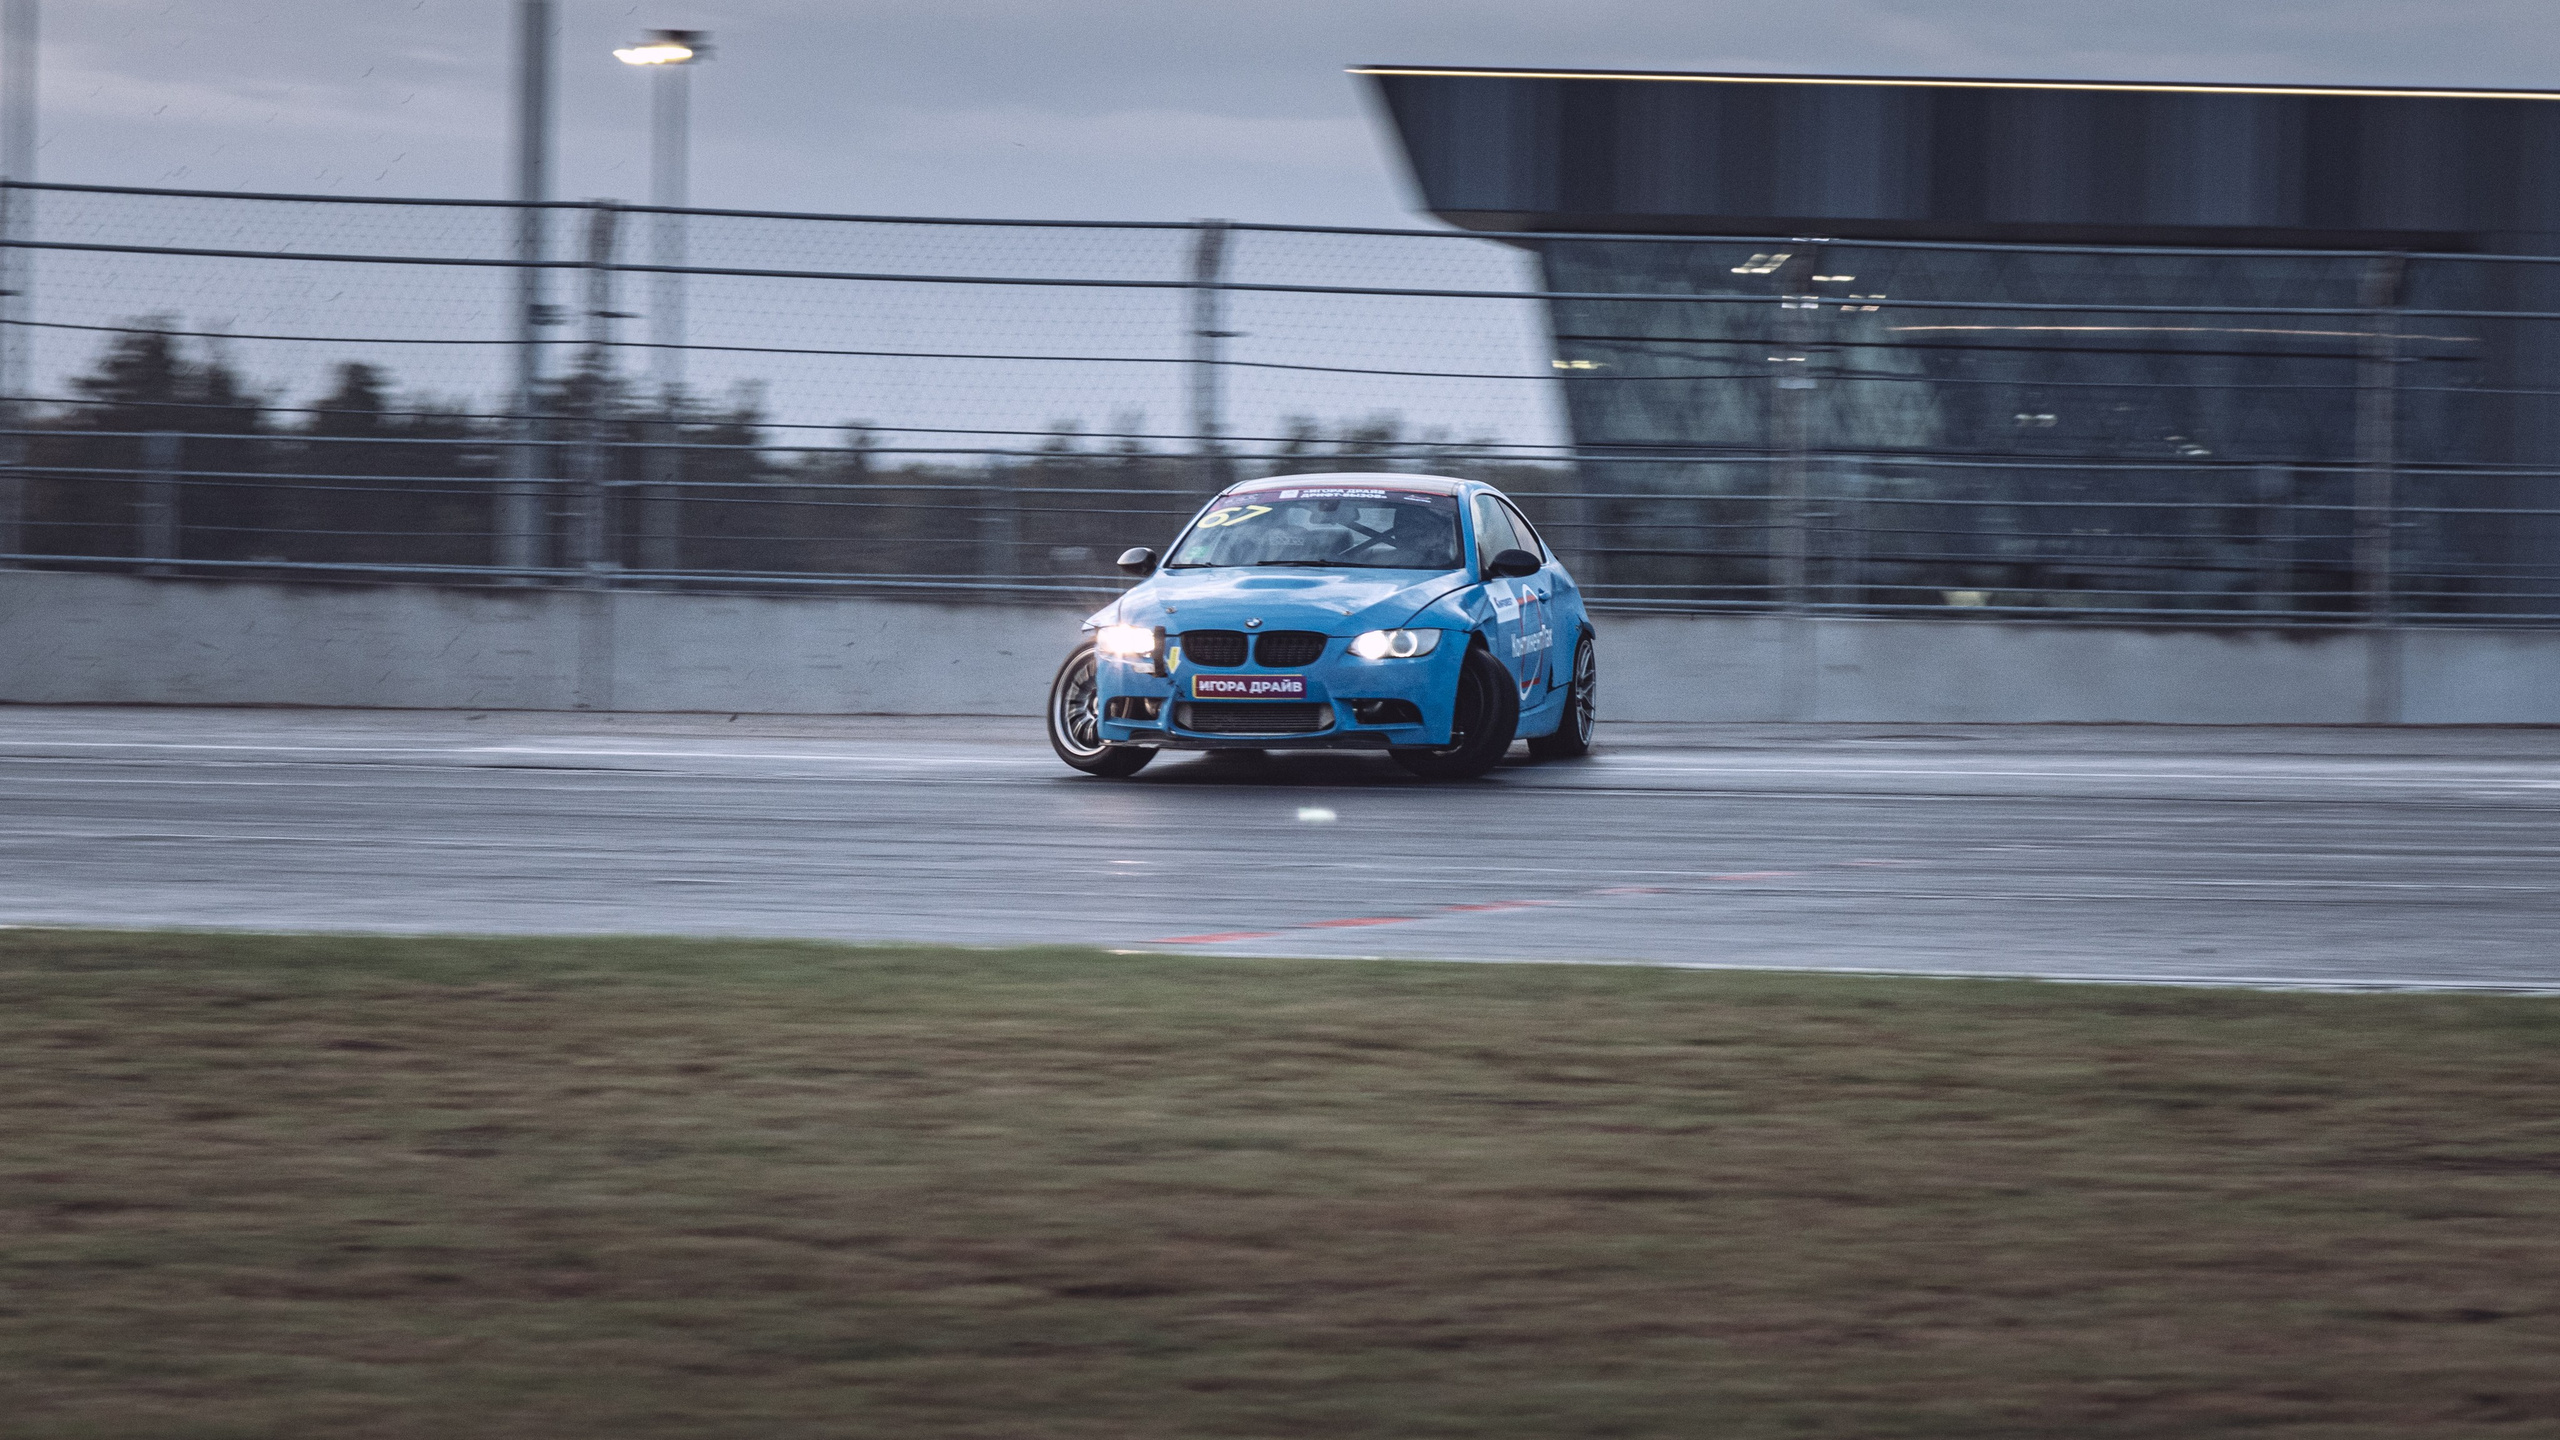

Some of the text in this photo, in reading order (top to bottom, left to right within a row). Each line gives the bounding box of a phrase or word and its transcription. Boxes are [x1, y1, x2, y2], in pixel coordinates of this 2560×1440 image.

[1197, 505, 1273, 528] 67
[1198, 678, 1303, 694] ИГОРА ДРАЙВ
